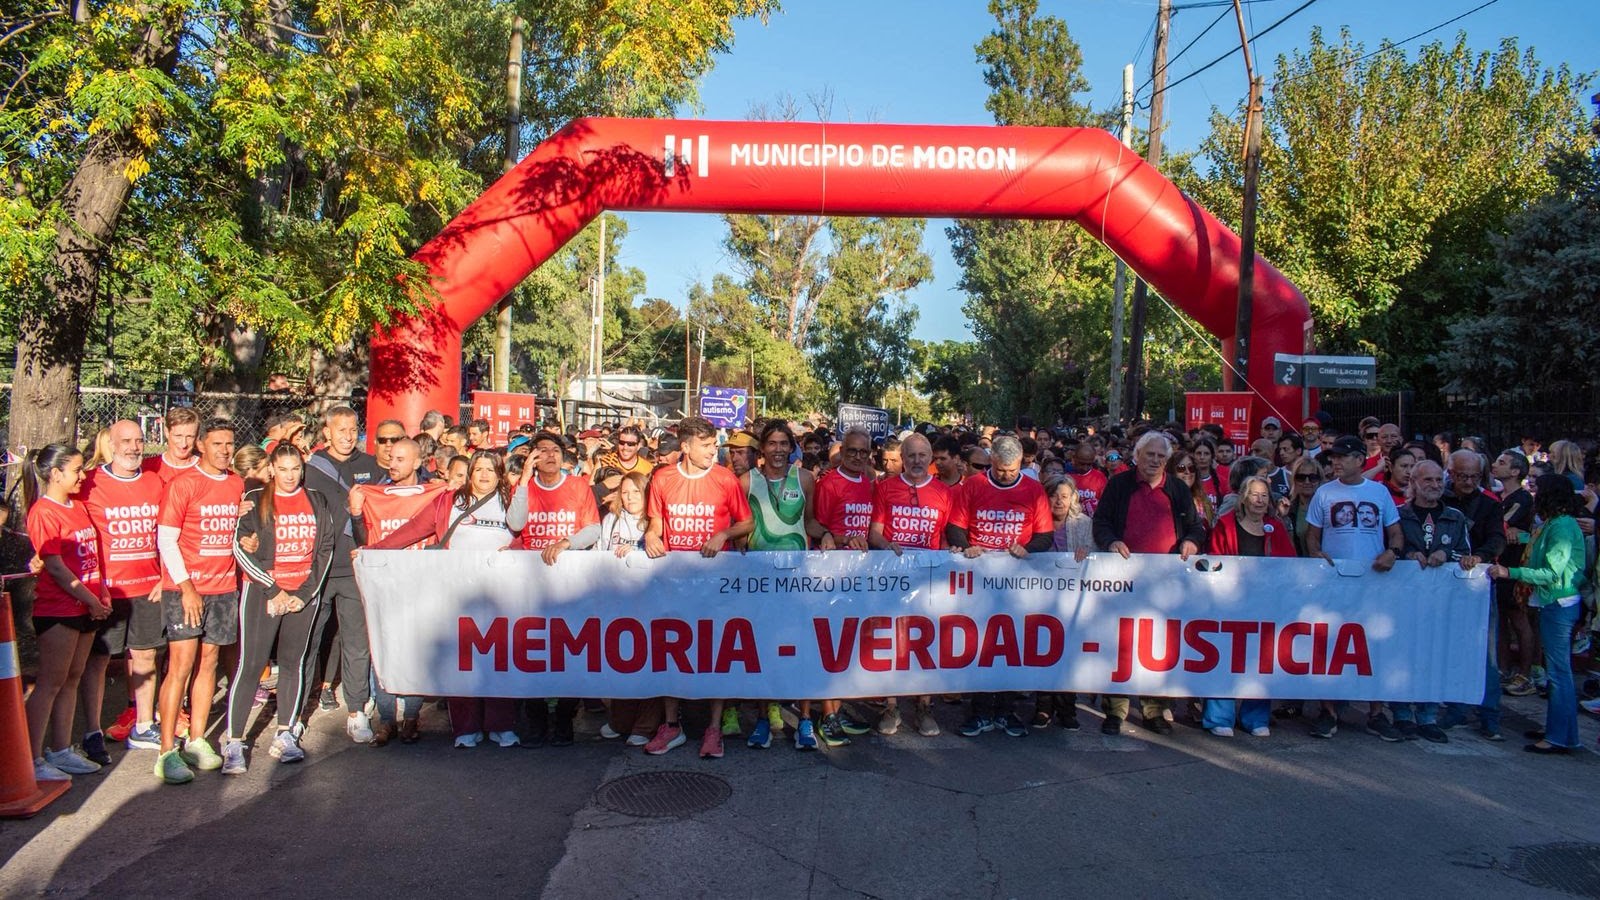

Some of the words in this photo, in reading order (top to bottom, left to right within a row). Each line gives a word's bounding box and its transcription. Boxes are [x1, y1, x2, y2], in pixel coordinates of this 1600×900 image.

[730, 143, 864, 167] MUNICIPIO
[872, 145, 904, 168] DE
[913, 146, 1017, 170] MORON
[842, 410, 879, 420] hablemos
[528, 509, 576, 522] MORÓN
[668, 502, 715, 516] MORÓN
[892, 505, 939, 519] MORÓN
[976, 509, 1025, 522] MORÓN
[276, 512, 317, 524] ORÓN
[528, 523, 575, 536] CORRE
[892, 517, 937, 533] CORRE
[976, 521, 1024, 535] CORRE
[275, 525, 317, 539] ORRE
[892, 532, 918, 543] 2026
[110, 537, 144, 549] 2026
[200, 535, 229, 545] 2026
[669, 535, 693, 545] 2026
[976, 533, 1003, 545] 2026
[275, 541, 298, 553] 026
[719, 577, 742, 594] 24
[747, 577, 770, 593] DE
[775, 576, 836, 593] MARZO
[841, 576, 863, 593] DE
[866, 575, 911, 592] 1976
[983, 577, 1054, 591] MUNICIPIO
[1057, 578, 1076, 592] DE
[1080, 579, 1135, 593] MORON
[458, 616, 762, 675] MEMORIA
[813, 614, 1066, 674] VERDAD
[1111, 617, 1374, 684] JUSTICIA
